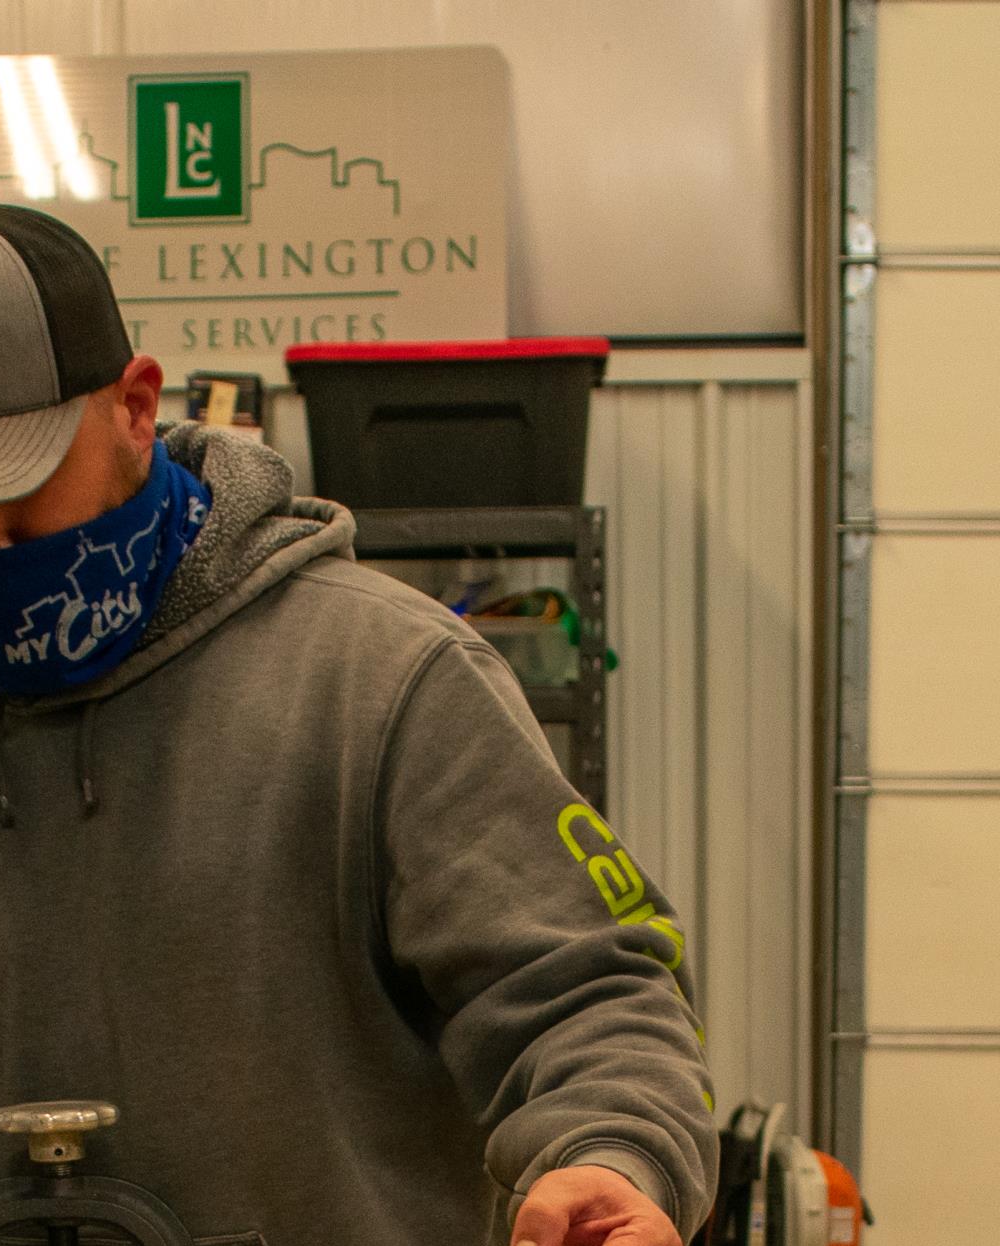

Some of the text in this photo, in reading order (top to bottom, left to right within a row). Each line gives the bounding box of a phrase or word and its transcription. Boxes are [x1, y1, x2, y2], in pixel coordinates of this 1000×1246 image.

[157, 235, 478, 281] LEXINGTON
[182, 313, 387, 349] SERVICES
[4, 582, 142, 664] MY City
